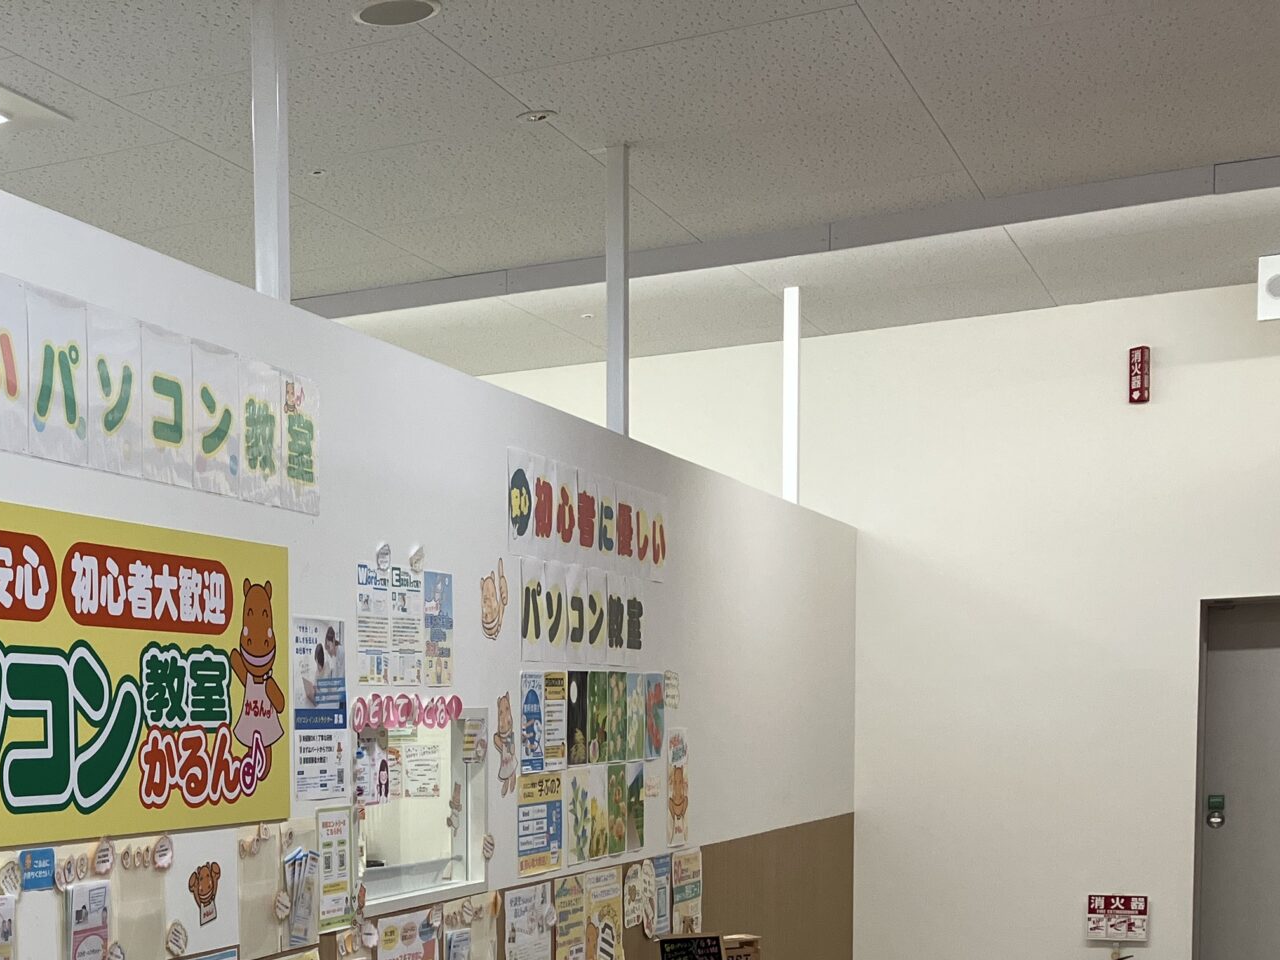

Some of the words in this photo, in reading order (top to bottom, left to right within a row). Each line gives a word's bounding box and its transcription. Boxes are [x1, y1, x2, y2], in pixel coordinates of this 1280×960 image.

[1130, 349, 1142, 390] 消火器
[71, 552, 226, 625] 初心者大歓迎
[522, 581, 644, 650] パソコン教室
[140, 642, 231, 730] 教室
[140, 725, 241, 809] かるん
[1090, 896, 1146, 910] 消火器
